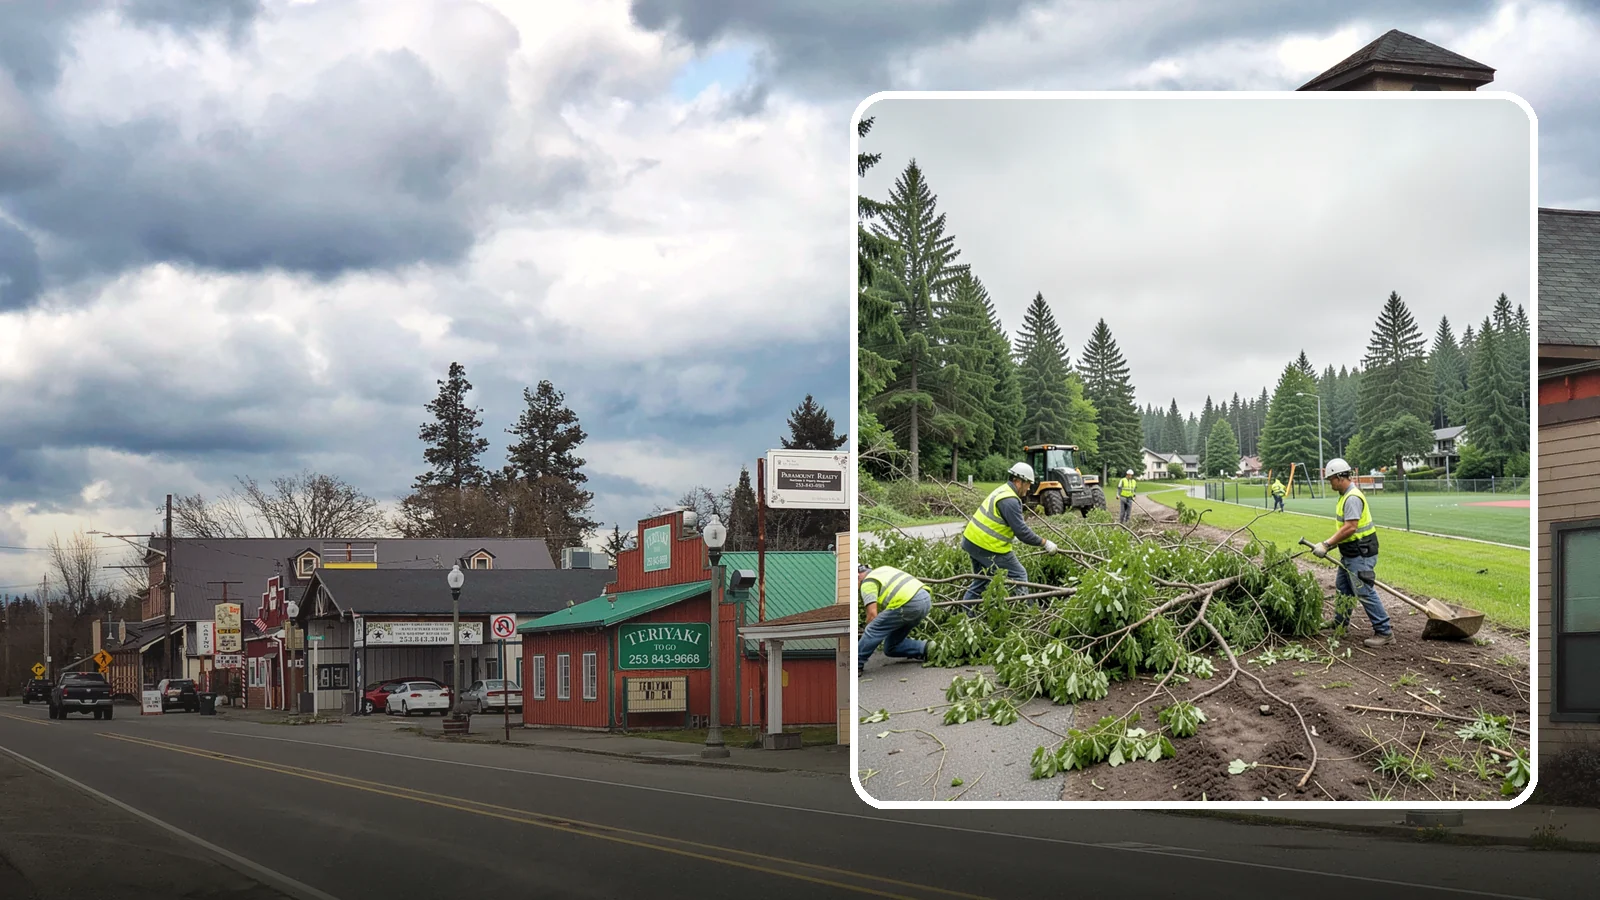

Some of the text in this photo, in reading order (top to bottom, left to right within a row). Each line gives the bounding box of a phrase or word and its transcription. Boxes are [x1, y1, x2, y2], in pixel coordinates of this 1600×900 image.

[624, 628, 702, 646] TERIYAKI
[629, 654, 700, 664] 253 843-9668
